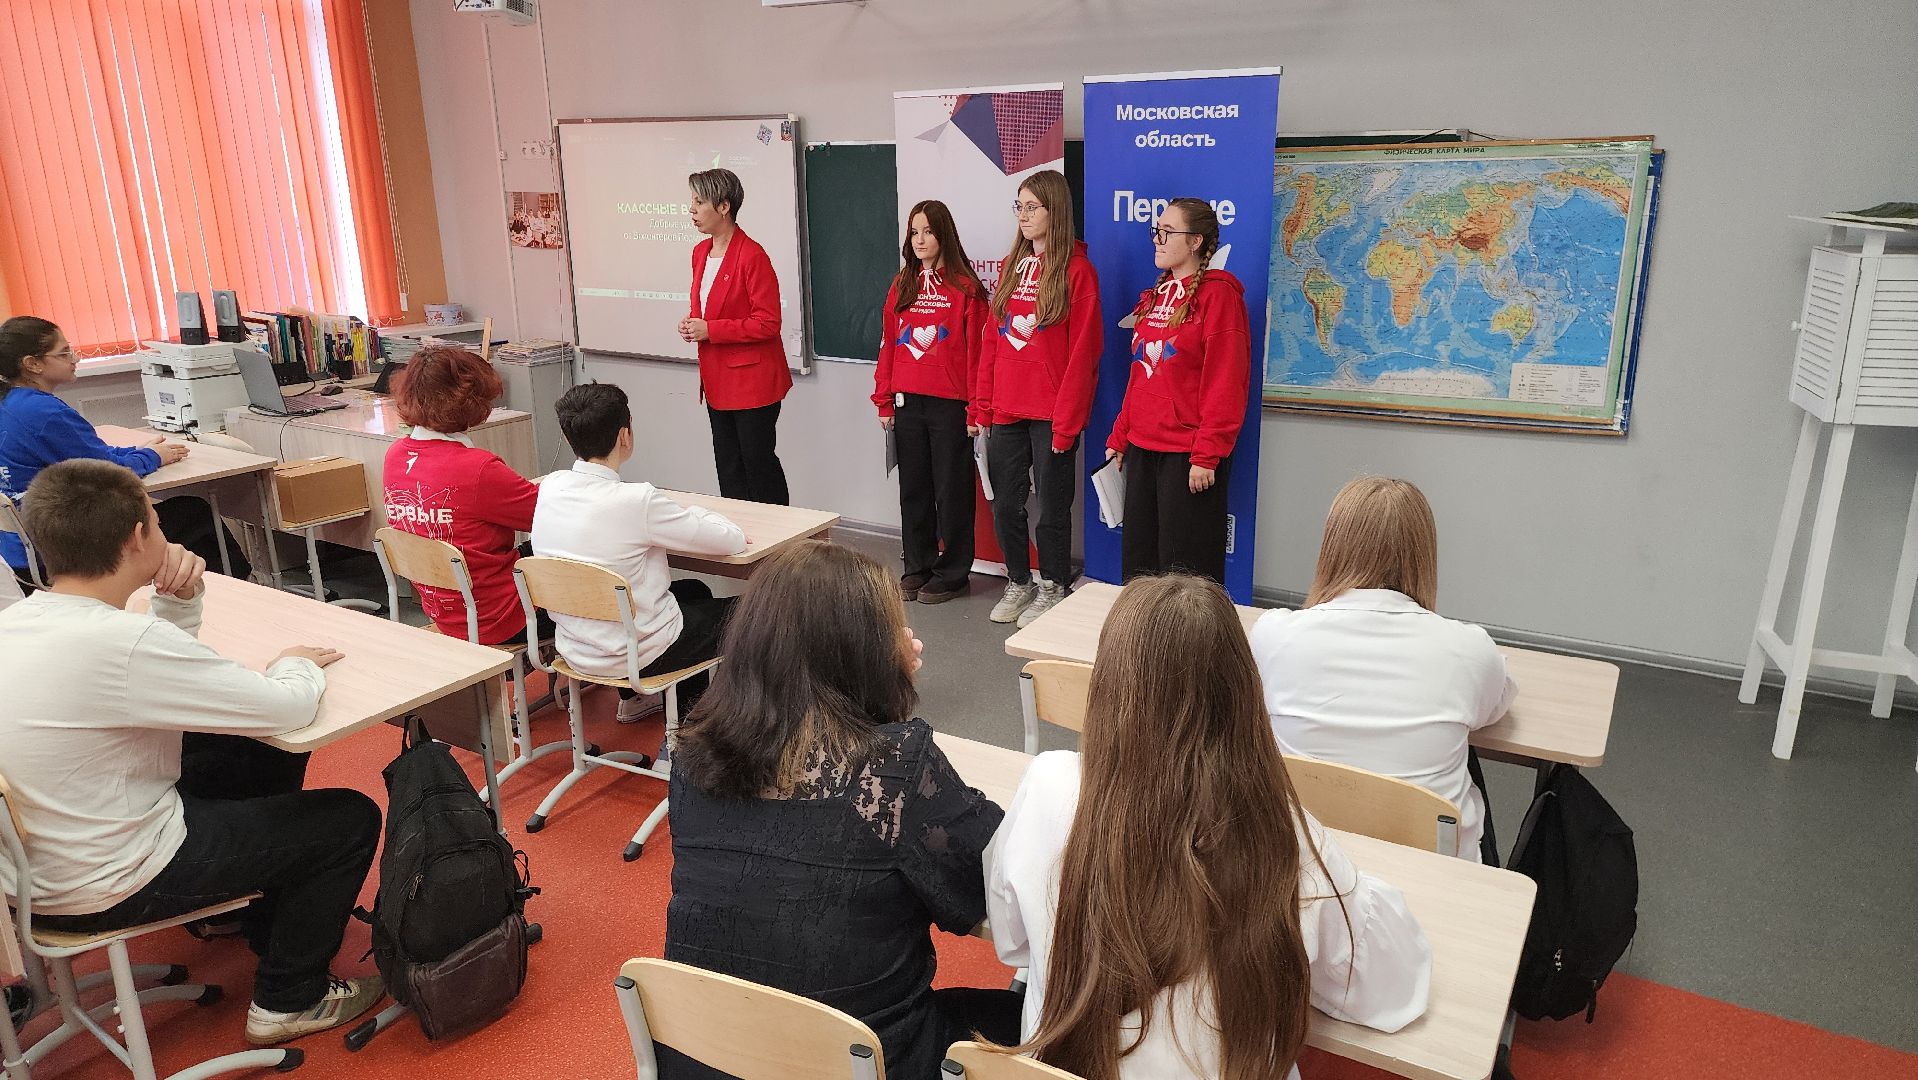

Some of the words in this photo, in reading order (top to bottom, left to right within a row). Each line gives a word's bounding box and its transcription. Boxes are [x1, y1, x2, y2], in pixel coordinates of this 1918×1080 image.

[1116, 104, 1239, 121] Московская
[1135, 129, 1216, 148] область
[617, 202, 677, 215] КЛАССНЫЕ
[1113, 190, 1236, 233] Пере
[384, 503, 453, 524] ЕРВЫЕ
